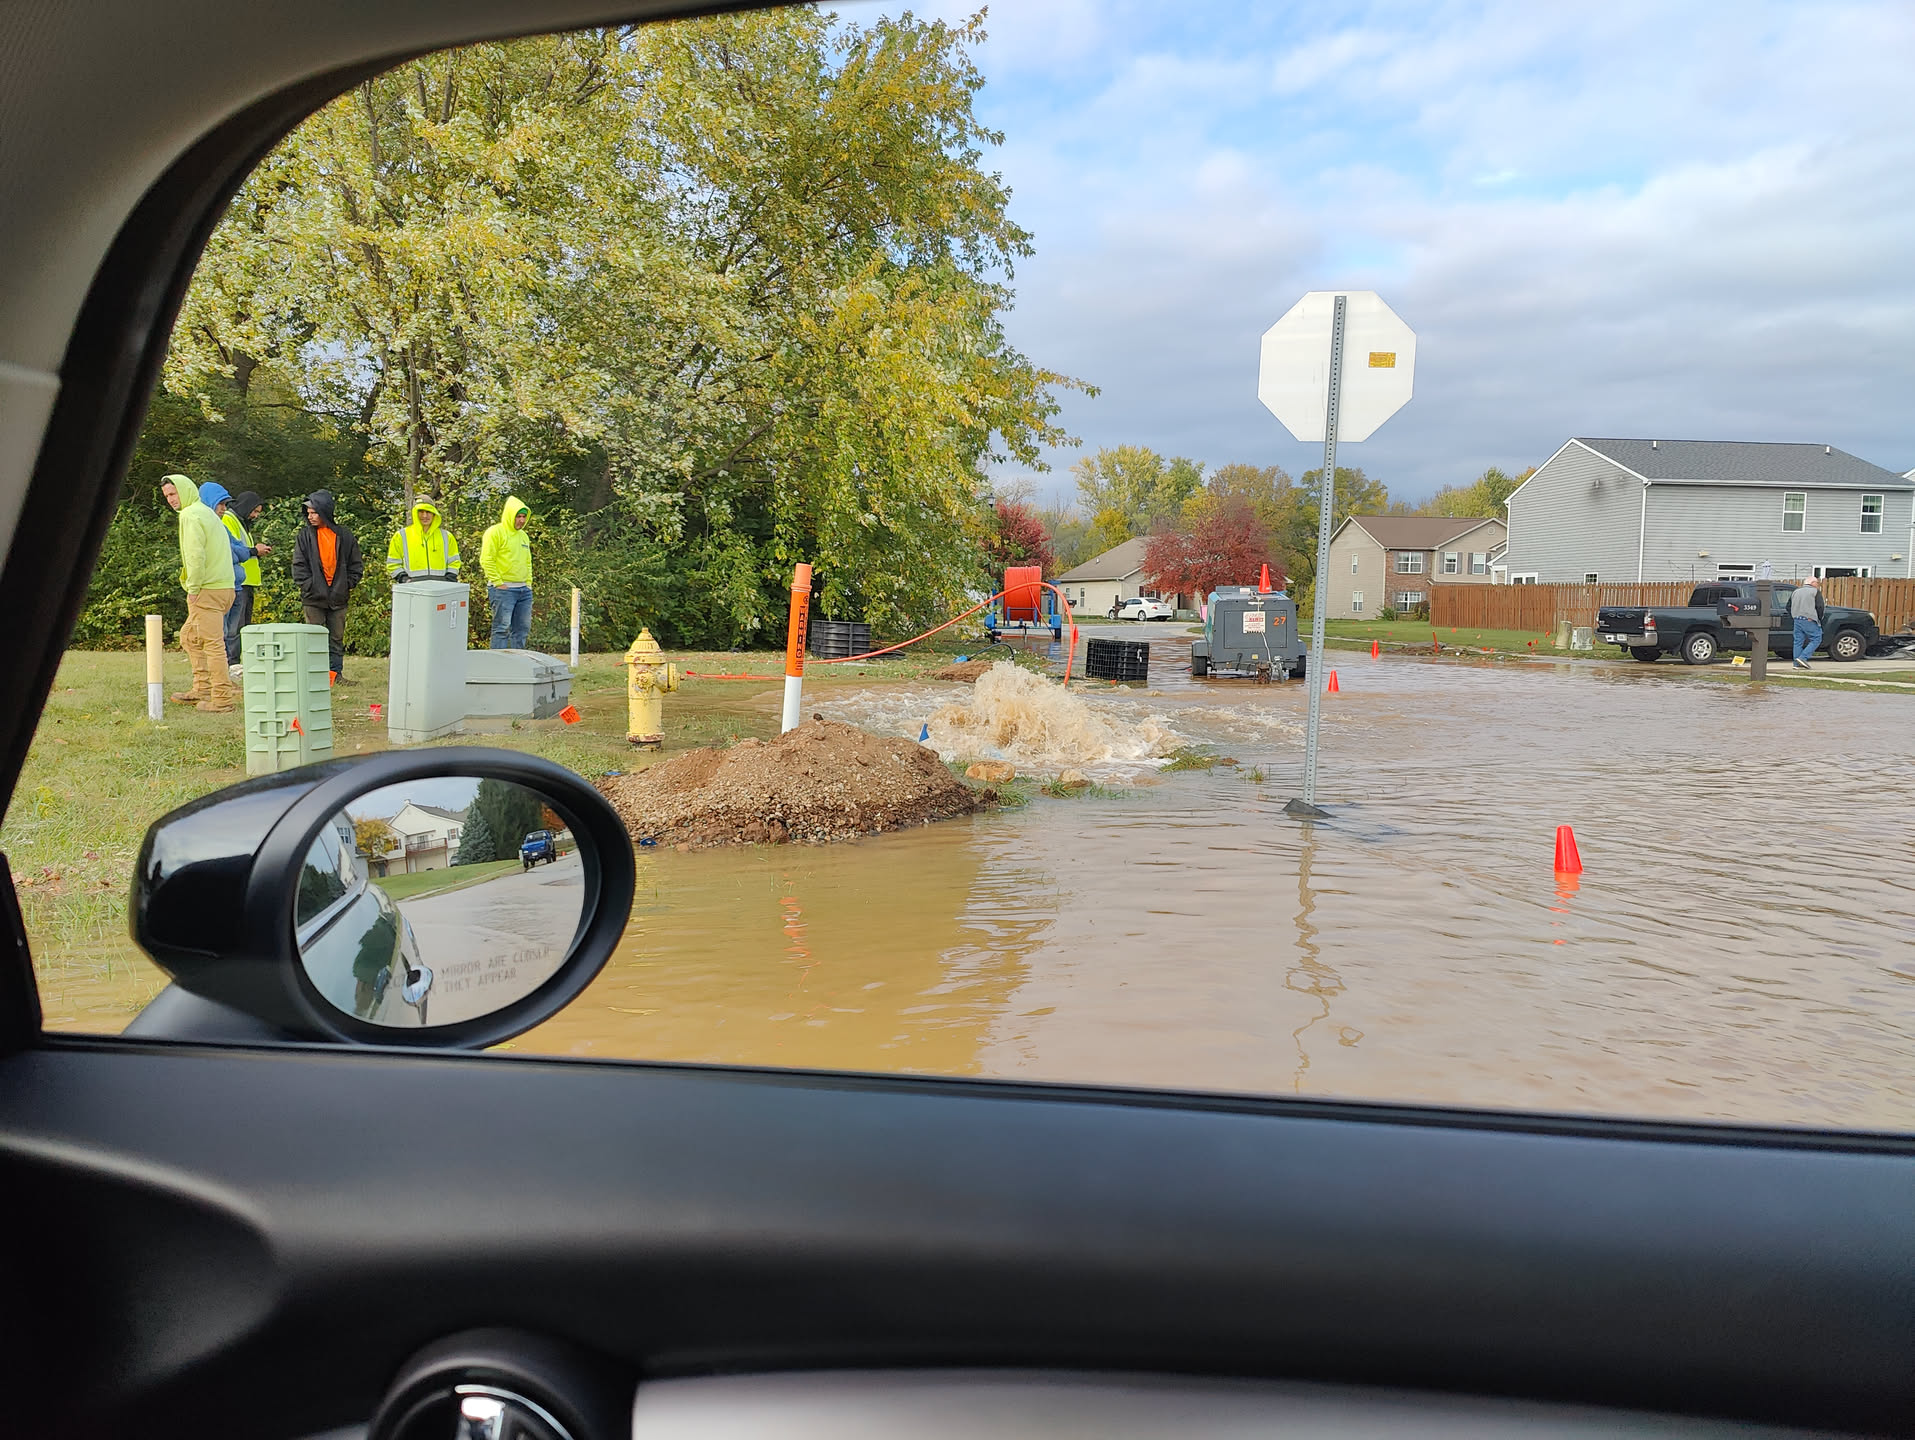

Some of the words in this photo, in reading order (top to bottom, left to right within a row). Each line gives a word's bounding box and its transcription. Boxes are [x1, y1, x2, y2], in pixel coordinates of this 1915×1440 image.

[1273, 616, 1287, 627] 27
[441, 960, 481, 977] MIRROR
[488, 955, 507, 969] ARE
[513, 947, 550, 963] CLOSER
[445, 977, 471, 992] THEY
[478, 967, 517, 986] APPEAR
